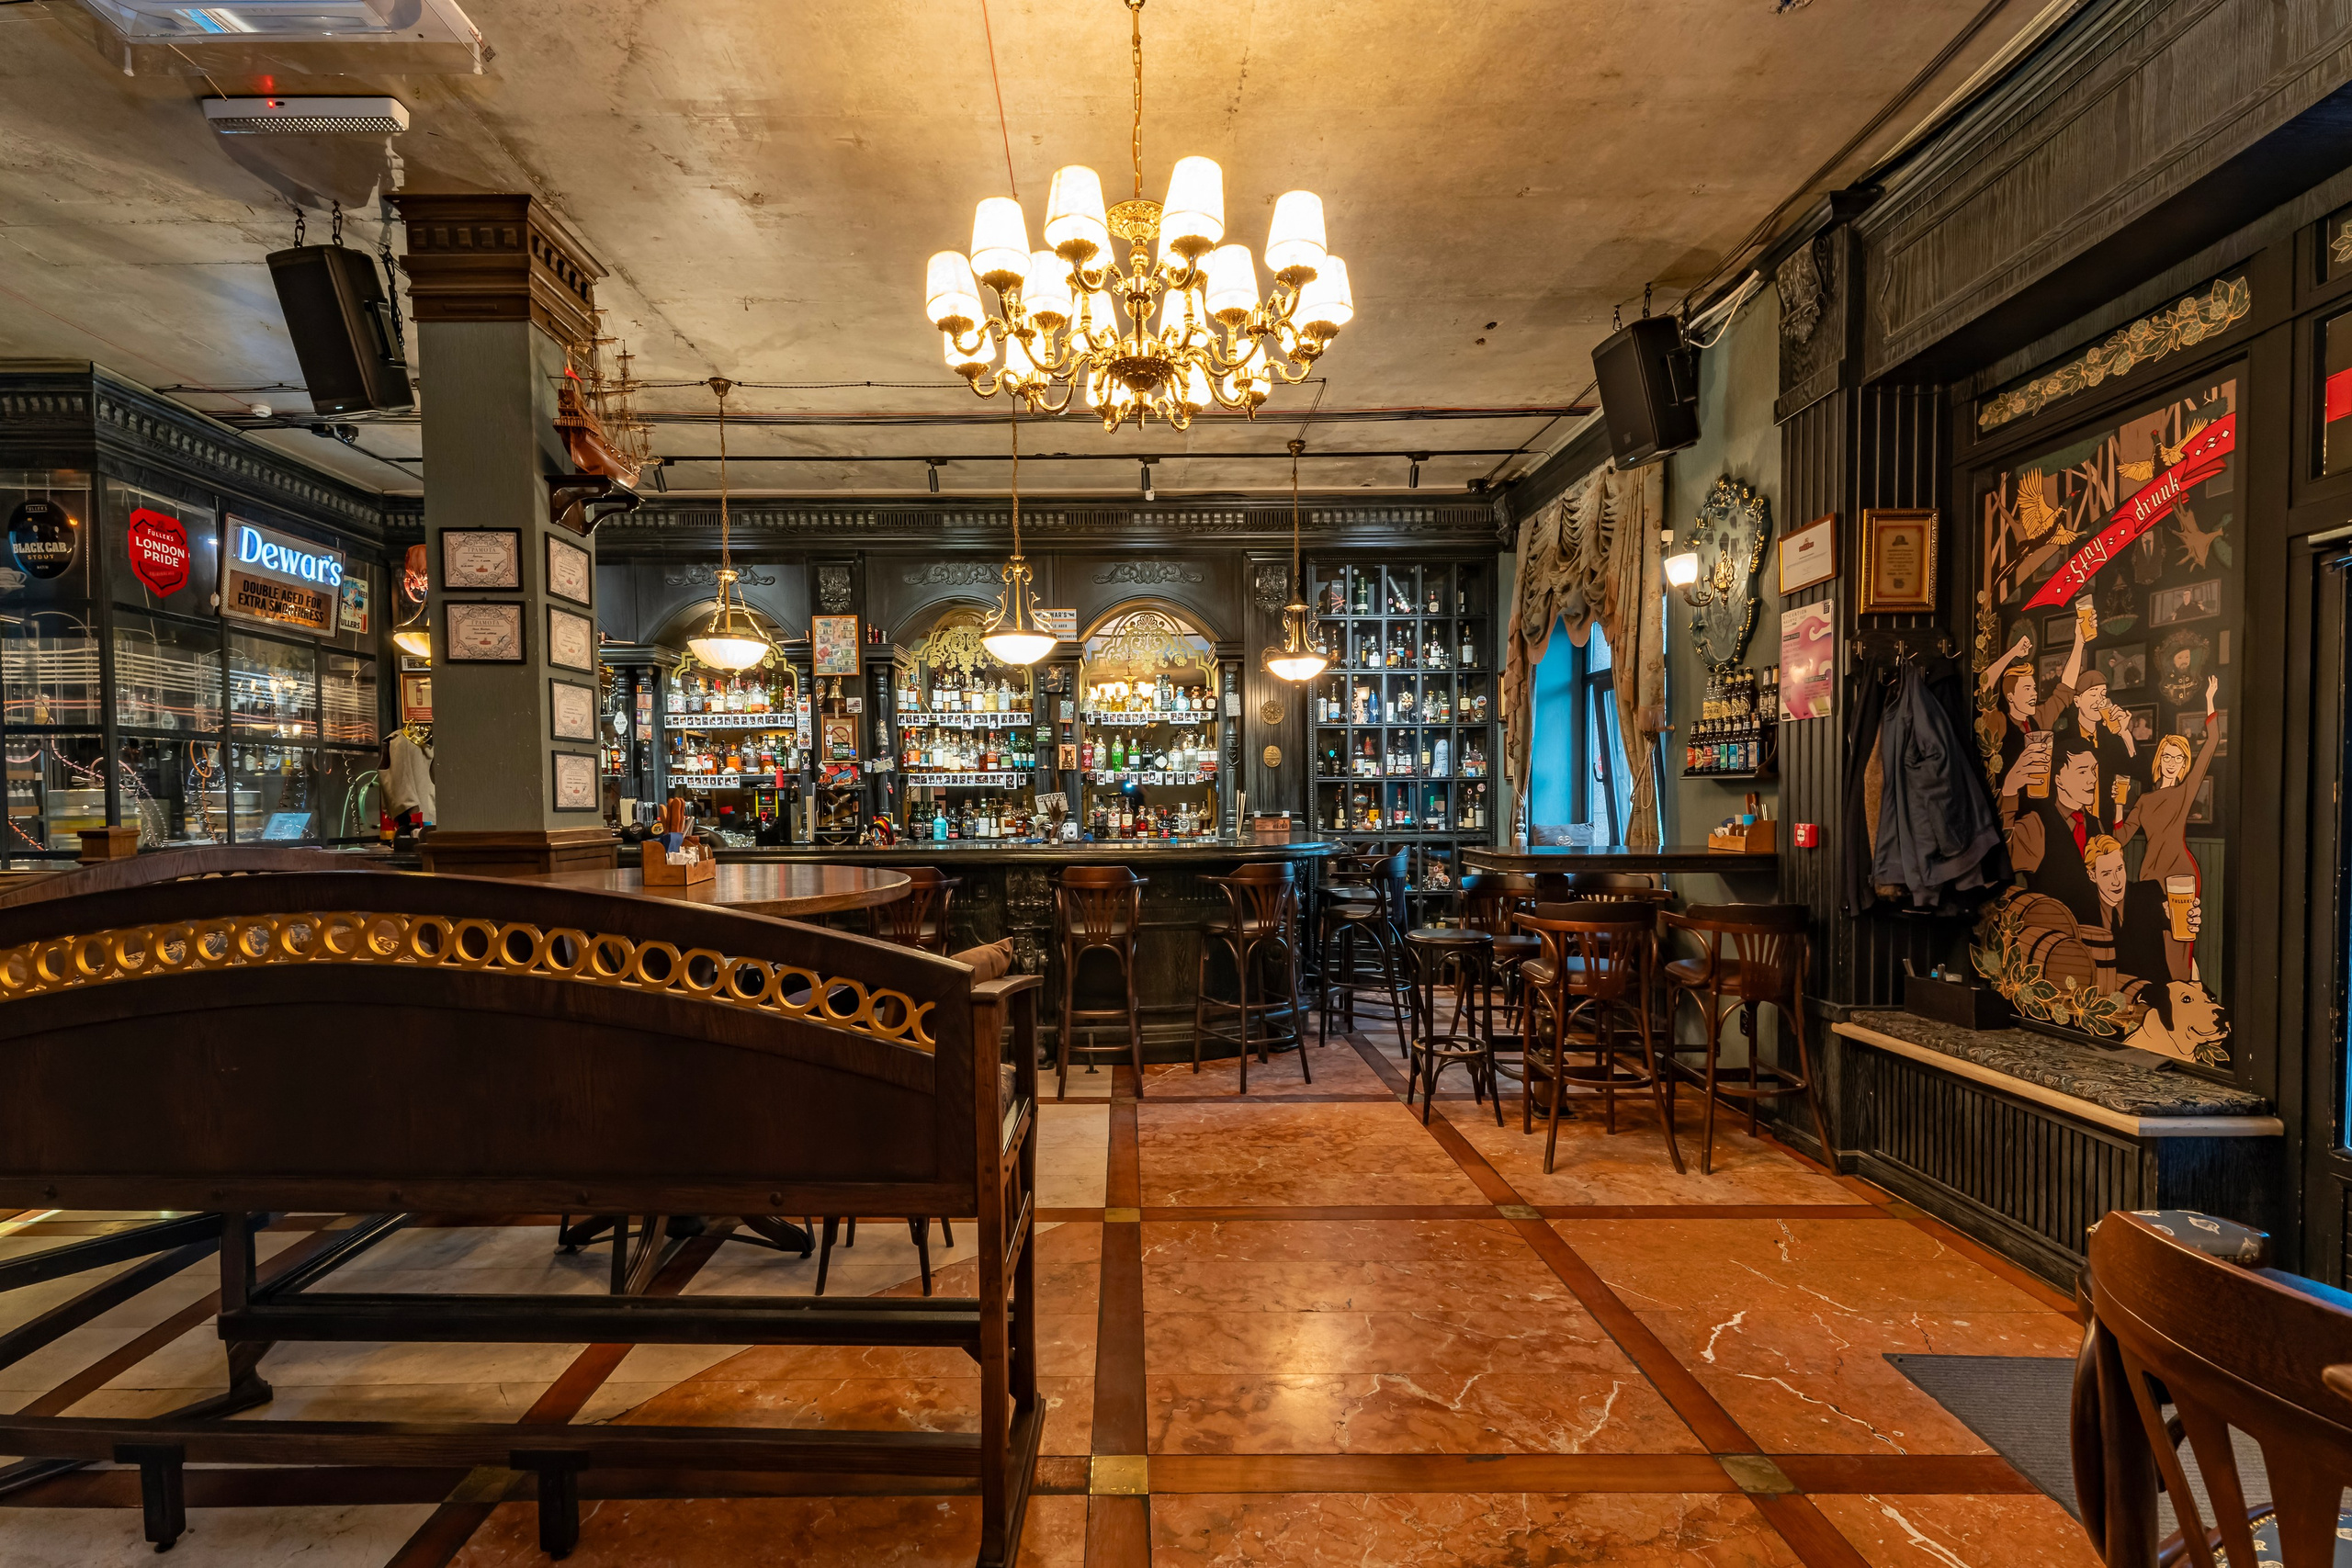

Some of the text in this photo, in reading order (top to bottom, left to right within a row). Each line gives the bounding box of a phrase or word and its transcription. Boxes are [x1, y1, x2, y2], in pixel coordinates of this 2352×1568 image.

[13, 542, 67, 553] BLACK CAB
[135, 536, 185, 558] LONDON
[239, 525, 343, 587] Dewar's
[143, 549, 179, 568] PRIDE
[2070, 537, 2108, 583] Stay
[238, 592, 266, 611] EXTRA
[243, 580, 322, 610] DOUBLE AGED FOR
[340, 618, 360, 629] ULLERS
